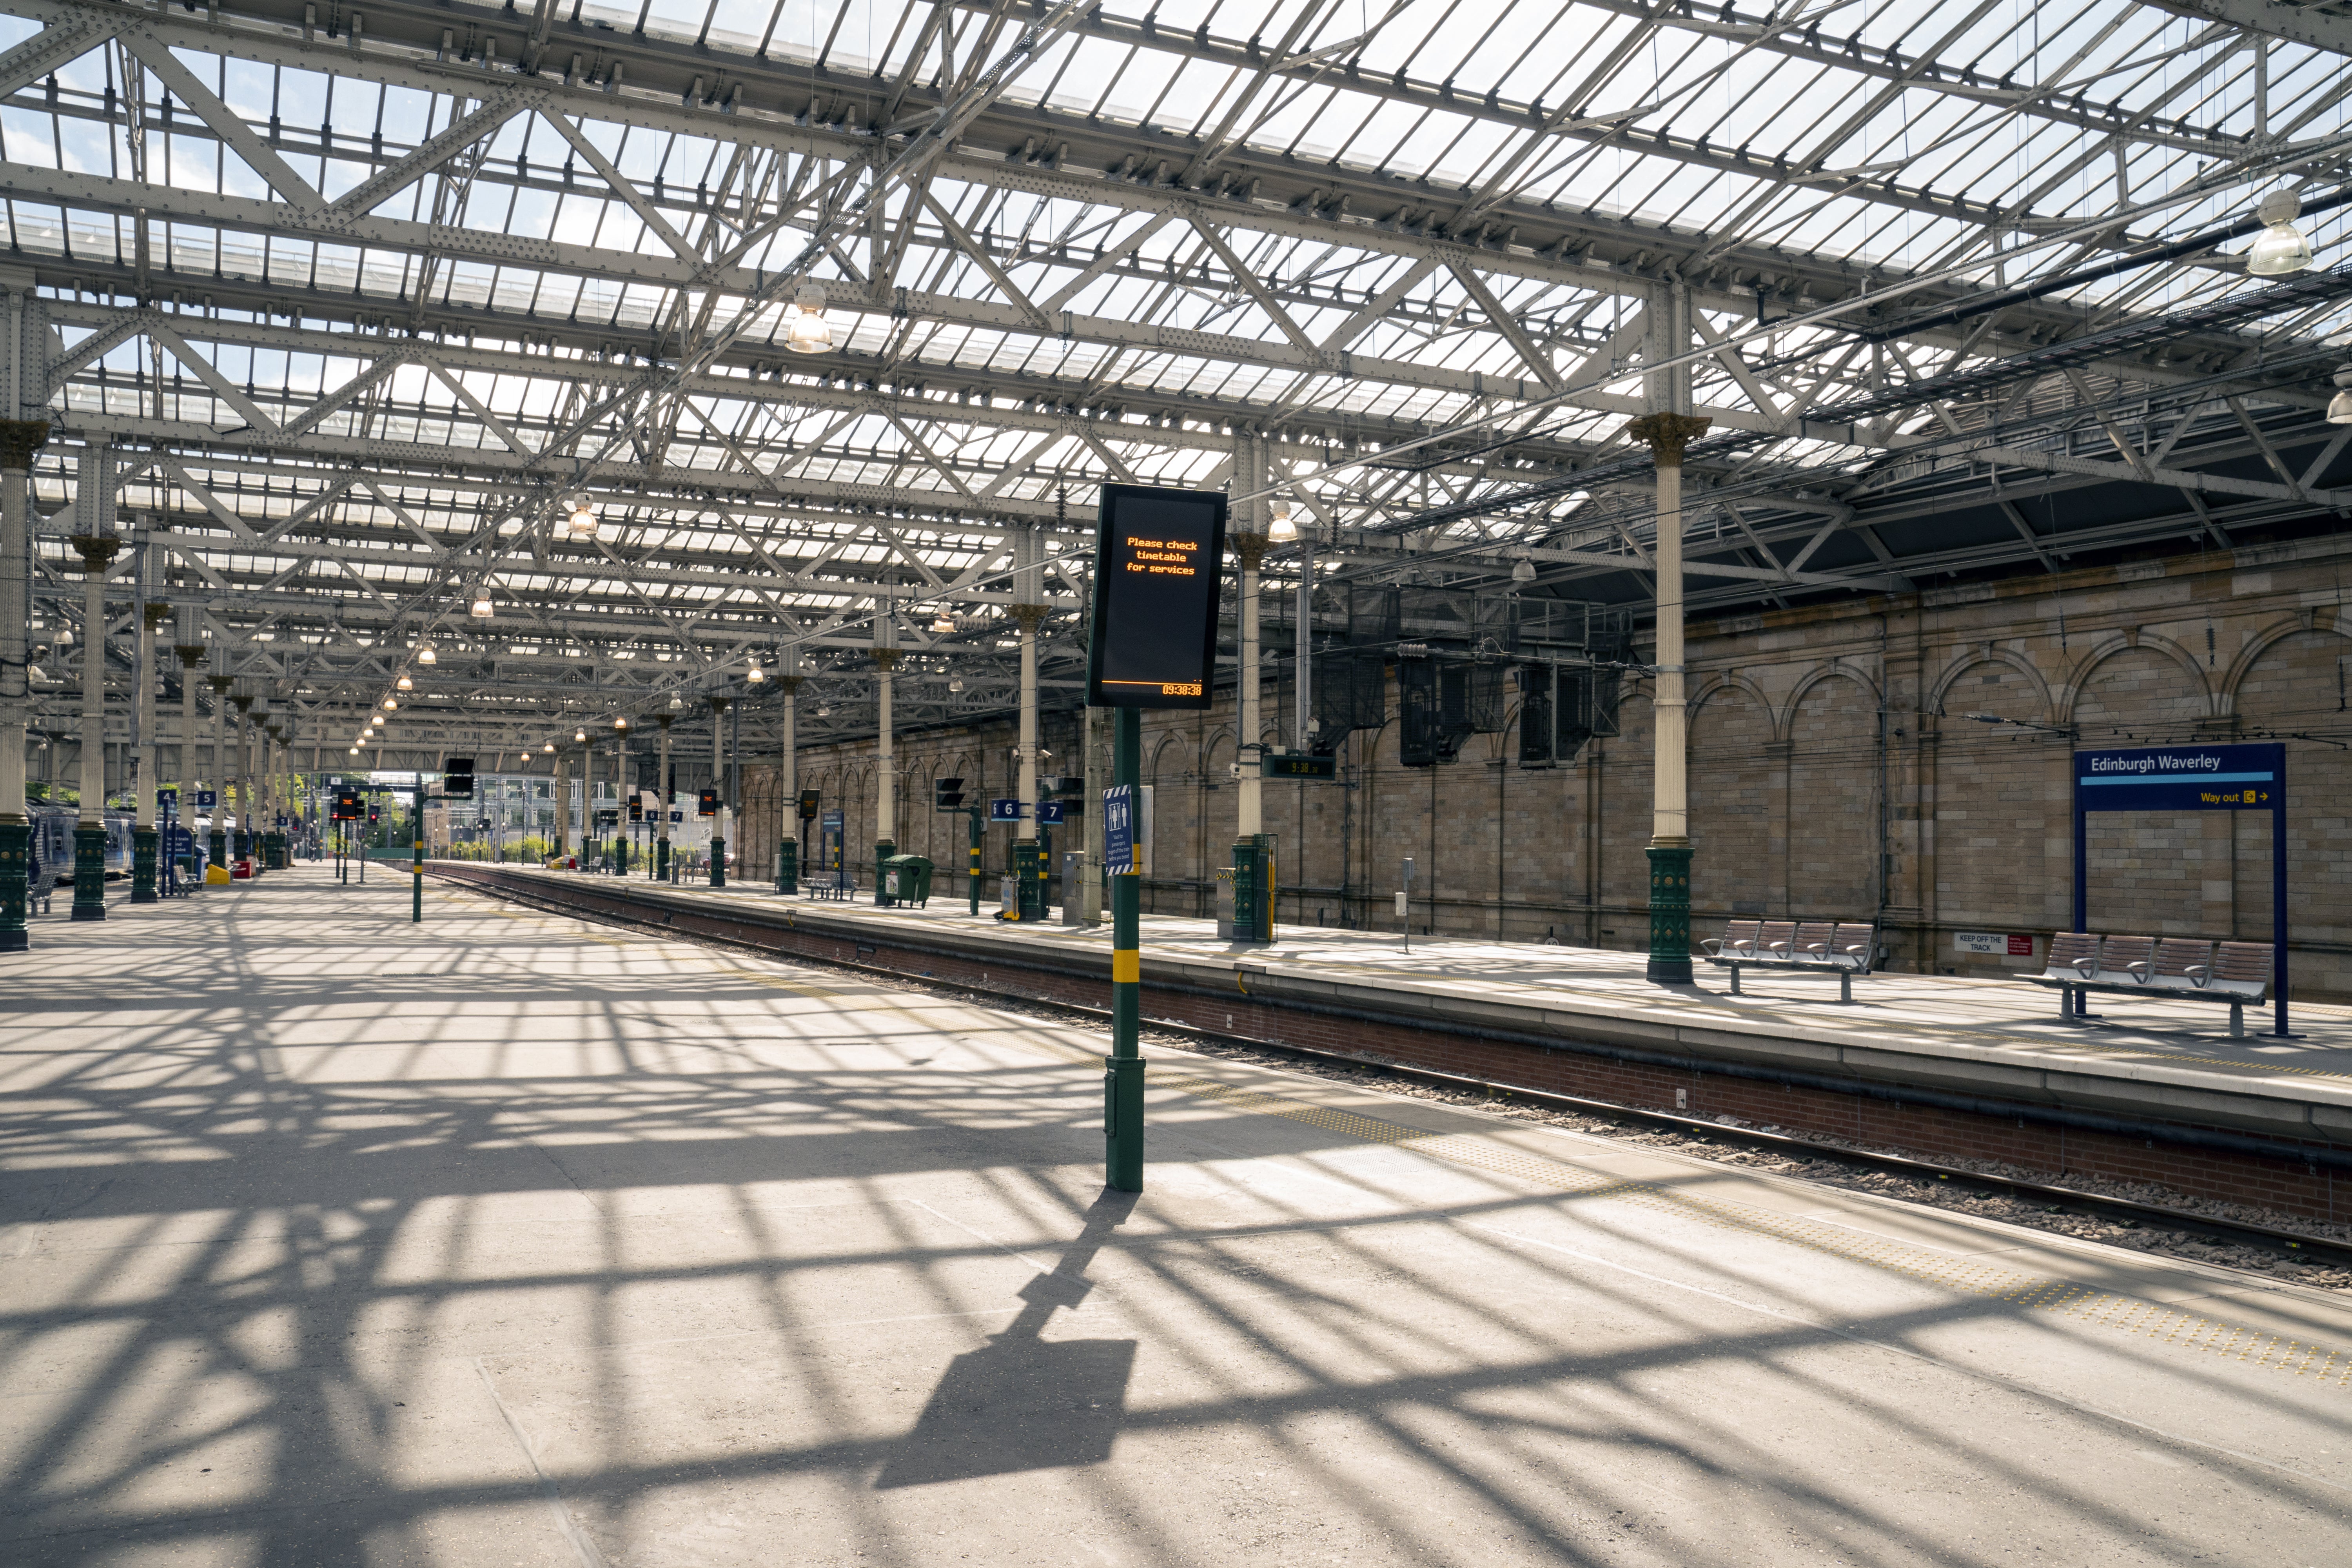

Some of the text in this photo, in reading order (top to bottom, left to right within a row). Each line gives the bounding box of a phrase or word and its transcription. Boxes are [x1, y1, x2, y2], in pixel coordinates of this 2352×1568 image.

[1128, 537, 1197, 550] Please check
[1136, 550, 1187, 562] timetable
[1127, 562, 1194, 575] for services
[1163, 685, 1201, 695] 09:38:38
[2092, 754, 2221, 773] Edinburgh Waverley
[204, 794, 211, 803] 5
[2201, 793, 2239, 804] Way out
[993, 804, 996, 814] 6
[1005, 804, 1013, 815] 6
[1050, 806, 1057, 817] 7
